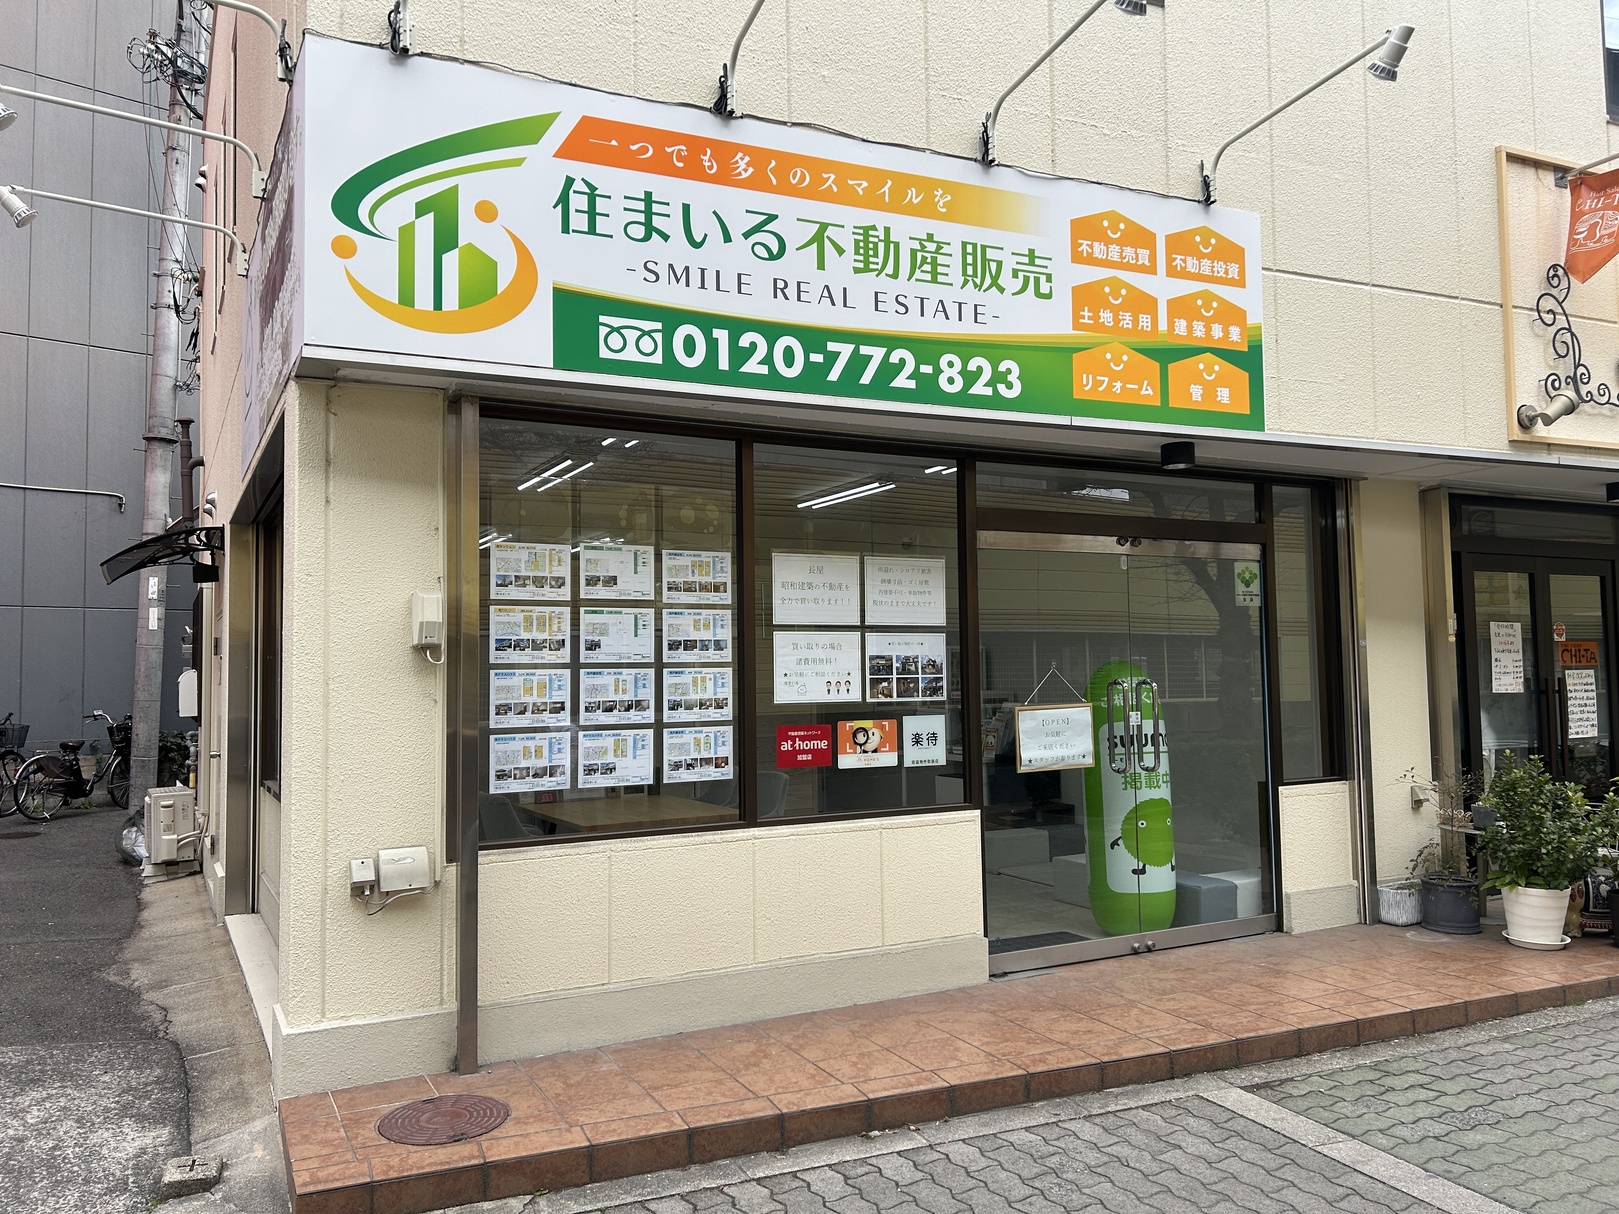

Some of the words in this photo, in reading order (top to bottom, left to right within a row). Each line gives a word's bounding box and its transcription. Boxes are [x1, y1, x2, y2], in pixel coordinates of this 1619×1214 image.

[589, 138, 952, 213] 一つでも多くのスマイルを
[552, 174, 1054, 301] 住まいる不動産販売
[1077, 238, 1151, 267] 不動産売買
[1171, 254, 1240, 280] 不動産投資
[773, 276, 857, 310] REAL
[1079, 306, 1152, 332] 土地活用
[1173, 317, 1242, 342] 建築事業
[672, 324, 1022, 399] 0120-772-823
[1081, 373, 1154, 397] リフォーム
[1189, 384, 1231, 404] 管理
[808, 565, 825, 575] 長屋
[781, 581, 850, 592] 昭和建築の不動産を
[791, 641, 843, 651] 買い取りの場合
[795, 657, 838, 666] 諸費用無料！
[780, 738, 794, 751] at
[795, 737, 828, 750] home
[911, 731, 938, 747] 楽待
